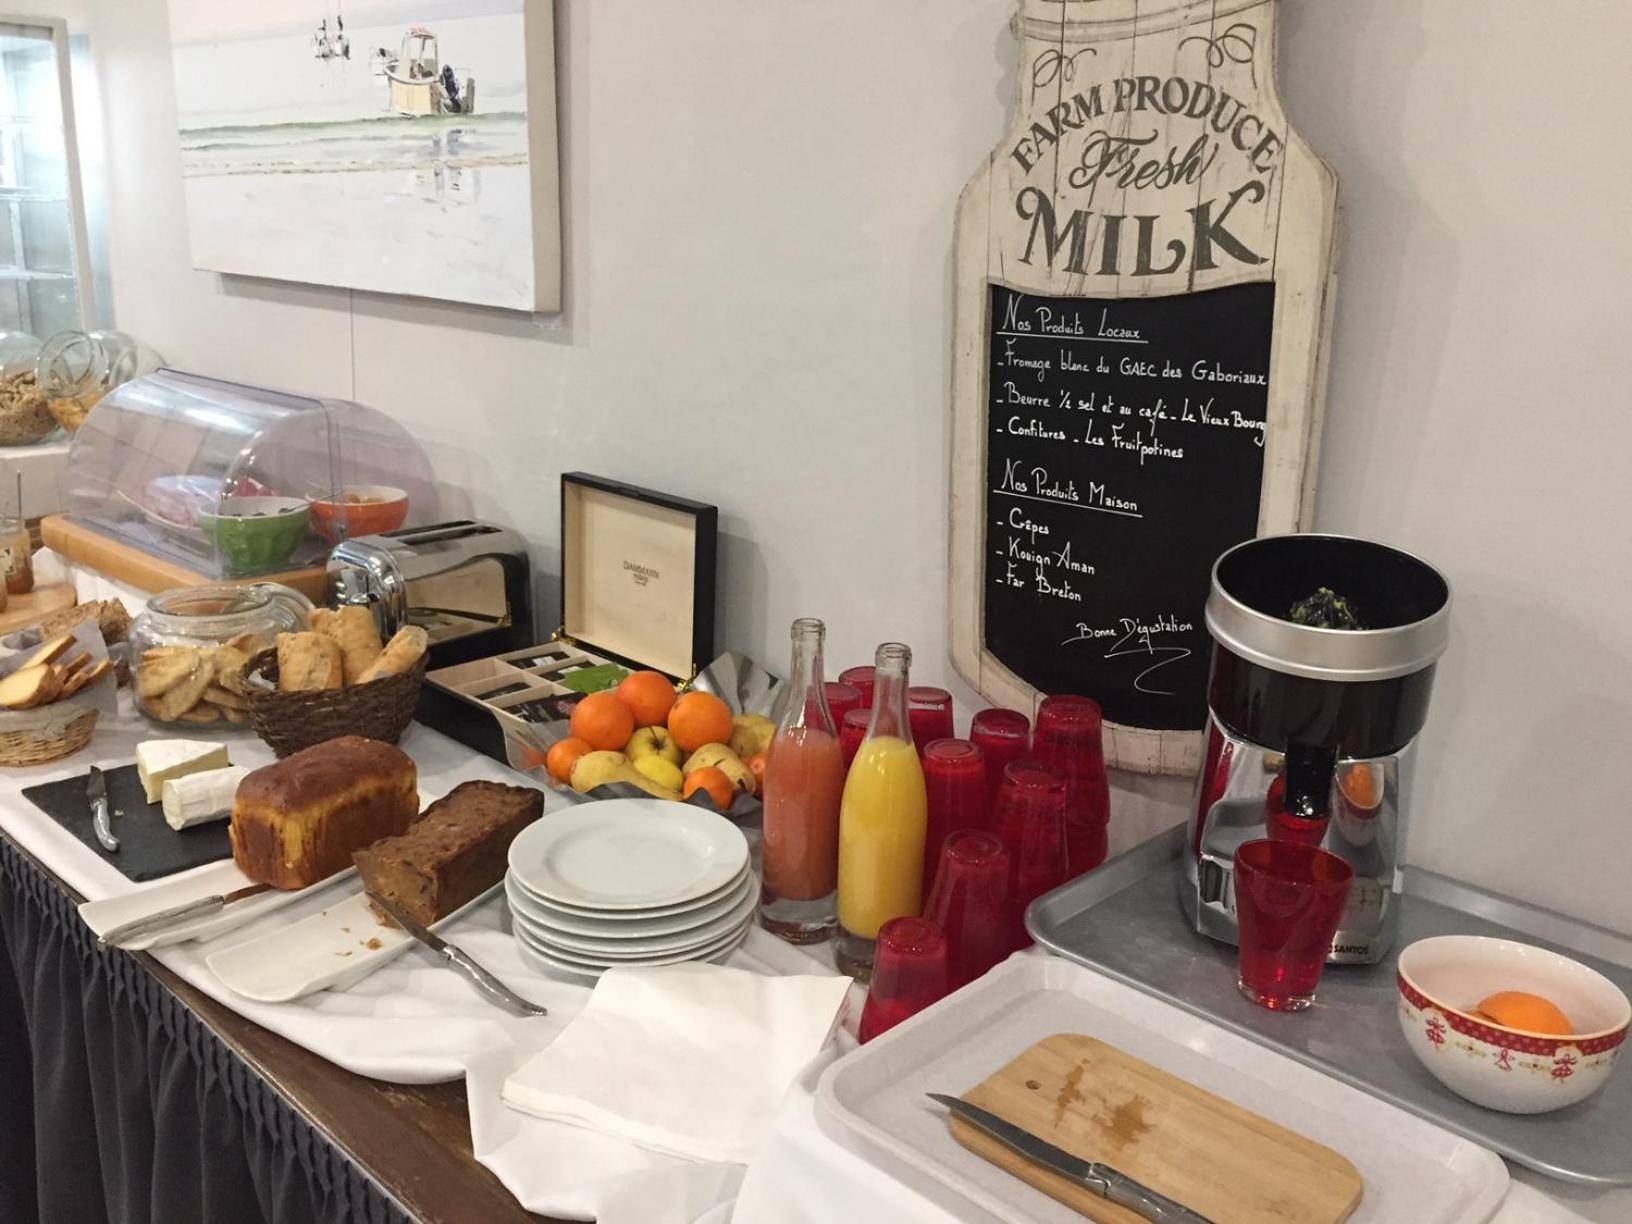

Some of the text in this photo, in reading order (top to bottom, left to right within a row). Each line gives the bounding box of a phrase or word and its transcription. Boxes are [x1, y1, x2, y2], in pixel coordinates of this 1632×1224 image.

[1010, 76, 1284, 174] FARM PRODUCE
[1069, 129, 1218, 190] Fresh
[1015, 180, 1269, 277] MILK
[1002, 293, 1140, 339] Nos Produits Locaux
[1005, 338, 1267, 385] Fromage blanc du GAEC des Gaboriaux
[1004, 381, 1051, 408] Beurre
[1077, 392, 1094, 411] sel
[1102, 395, 1114, 413] et
[1119, 406, 1131, 415] au
[1140, 399, 1168, 437] café
[1181, 398, 1196, 422] Le
[1200, 397, 1229, 427] Vieux
[1230, 411, 1267, 447] Bourg
[1008, 416, 1066, 440] Confitures
[1085, 419, 1105, 446] Les
[1001, 458, 1137, 511] Nos Produits Maison
[1009, 507, 1049, 545] Crêpes
[1009, 536, 1095, 579] Kouign Aman
[1006, 561, 1081, 601] Far Breton
[1062, 614, 1193, 653] Bonne Dégustation
[1334, 943, 1369, 955] SANTOS
